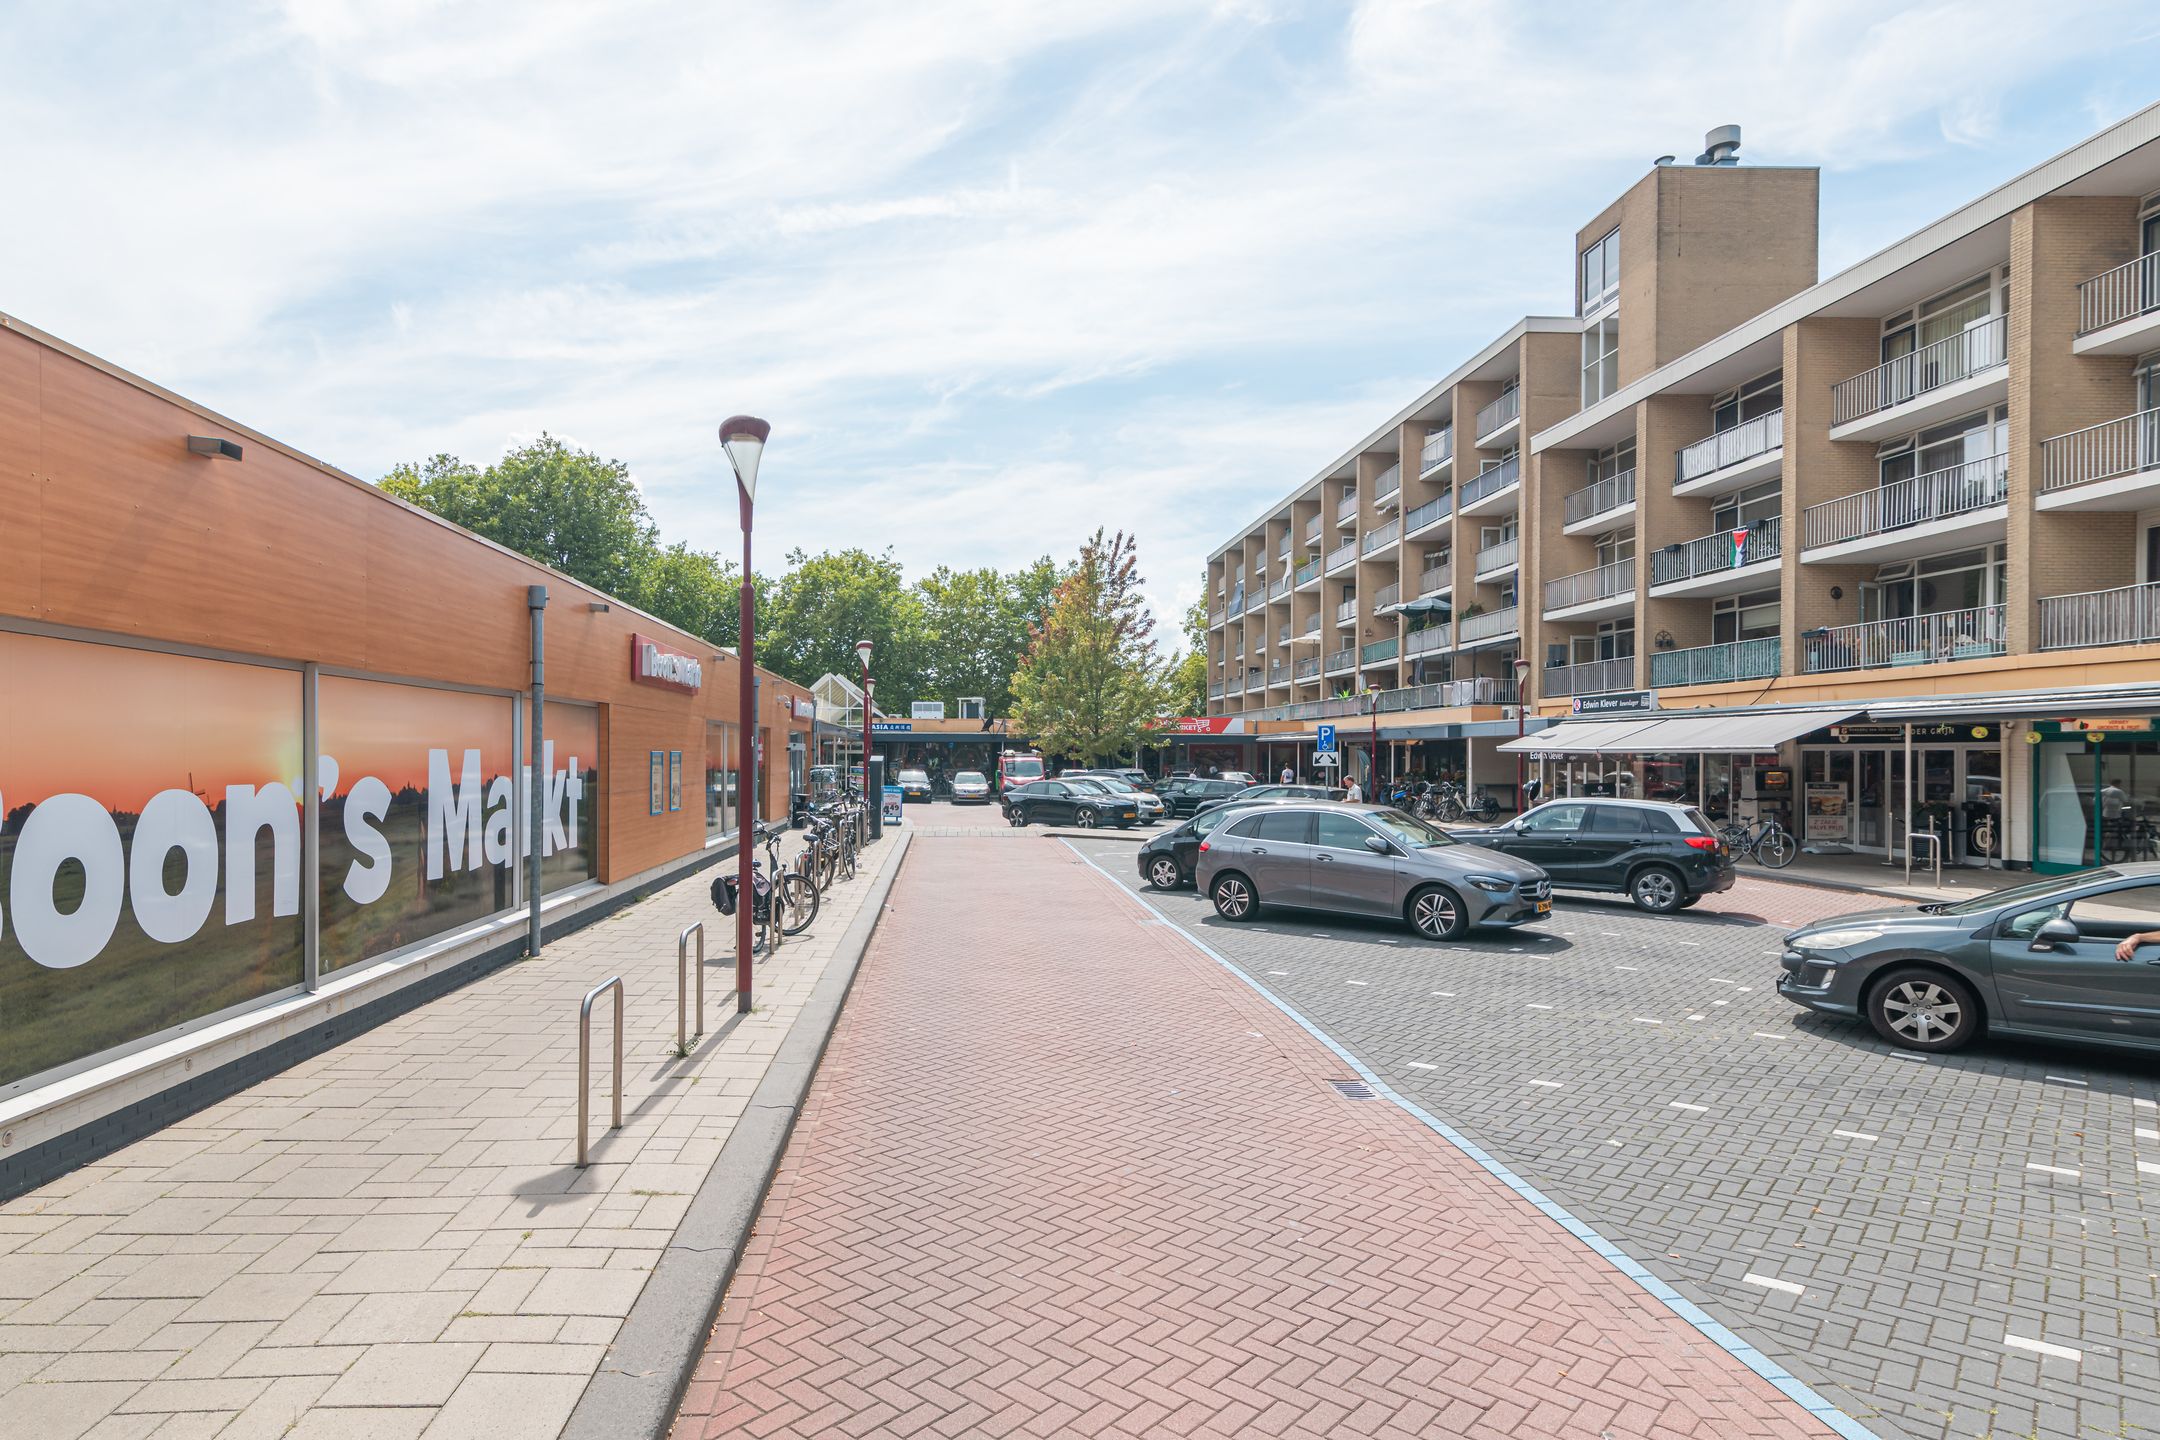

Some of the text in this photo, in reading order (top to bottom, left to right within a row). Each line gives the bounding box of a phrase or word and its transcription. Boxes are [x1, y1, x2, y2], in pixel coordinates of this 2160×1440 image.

[1583, 701, 1600, 709] Edwin
[1600, 700, 1618, 708] Klever
[1321, 727, 1331, 741] P
[0, 755, 392, 968] oon's
